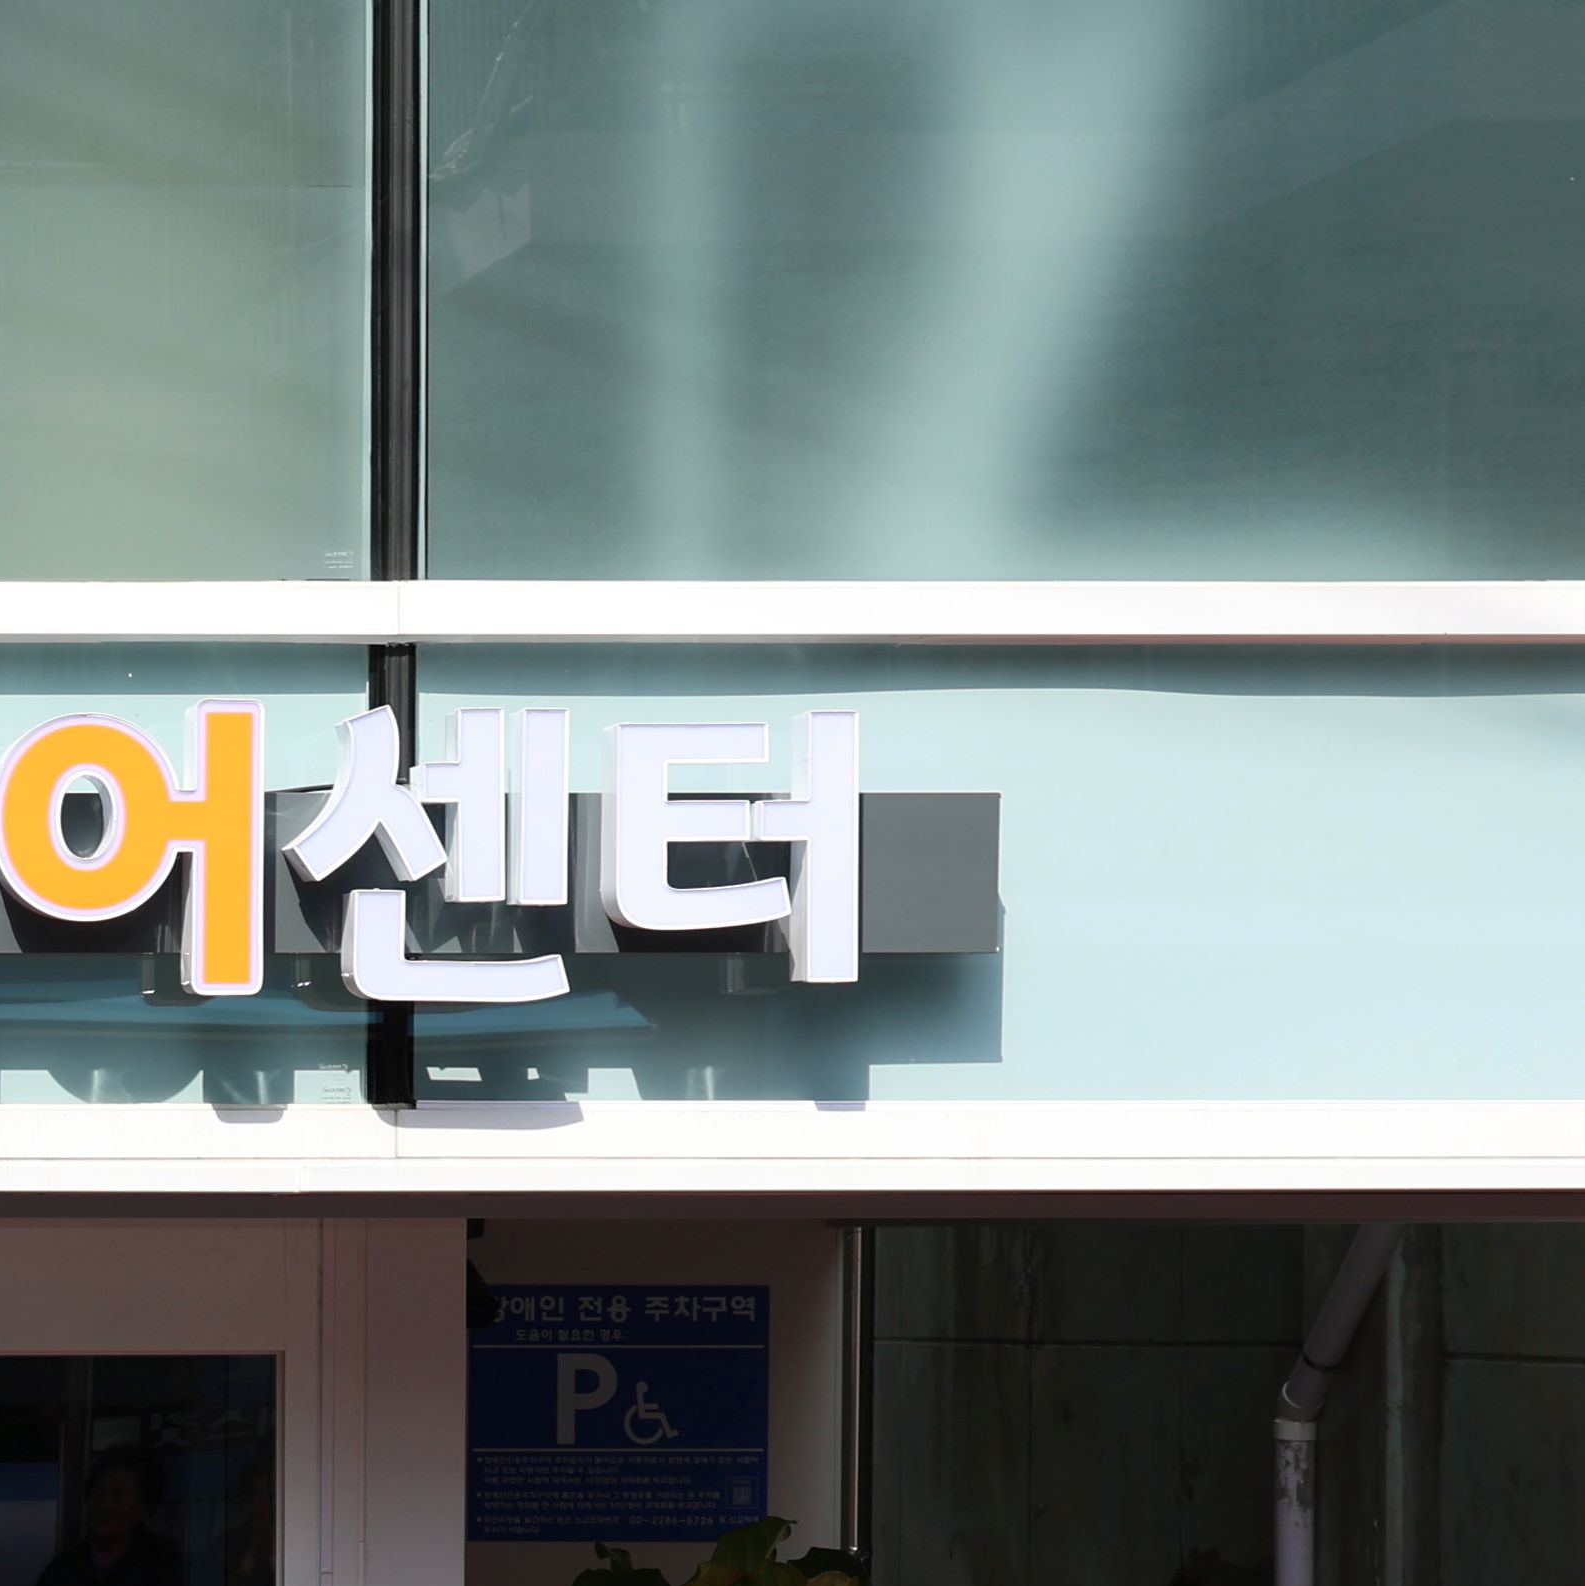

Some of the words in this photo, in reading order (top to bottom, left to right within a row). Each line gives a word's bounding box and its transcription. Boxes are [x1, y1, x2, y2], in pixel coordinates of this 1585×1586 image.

[578, 1295, 632, 1323] 전용
[644, 1295, 757, 1323] 주차구역
[557, 1352, 618, 1445] P
